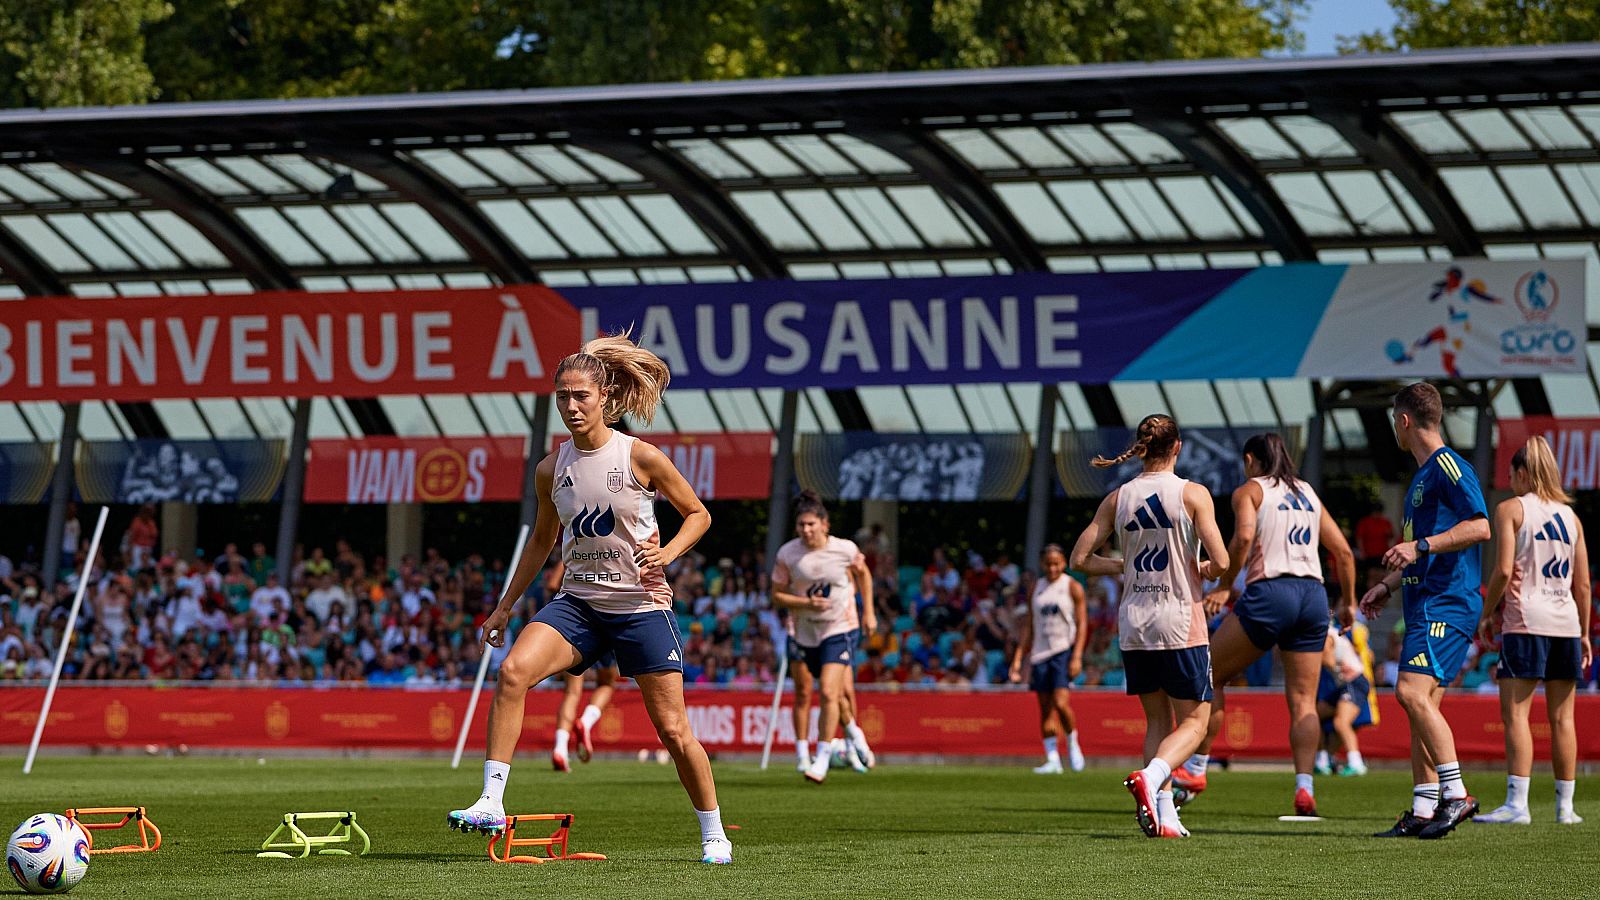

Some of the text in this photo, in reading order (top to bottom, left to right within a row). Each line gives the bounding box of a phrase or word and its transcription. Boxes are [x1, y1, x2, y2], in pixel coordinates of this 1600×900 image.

[488, 295, 544, 380] À
[572, 549, 621, 561] Iberdrola
[573, 572, 622, 582] EBRO
[1133, 583, 1170, 593] Iberdrola
